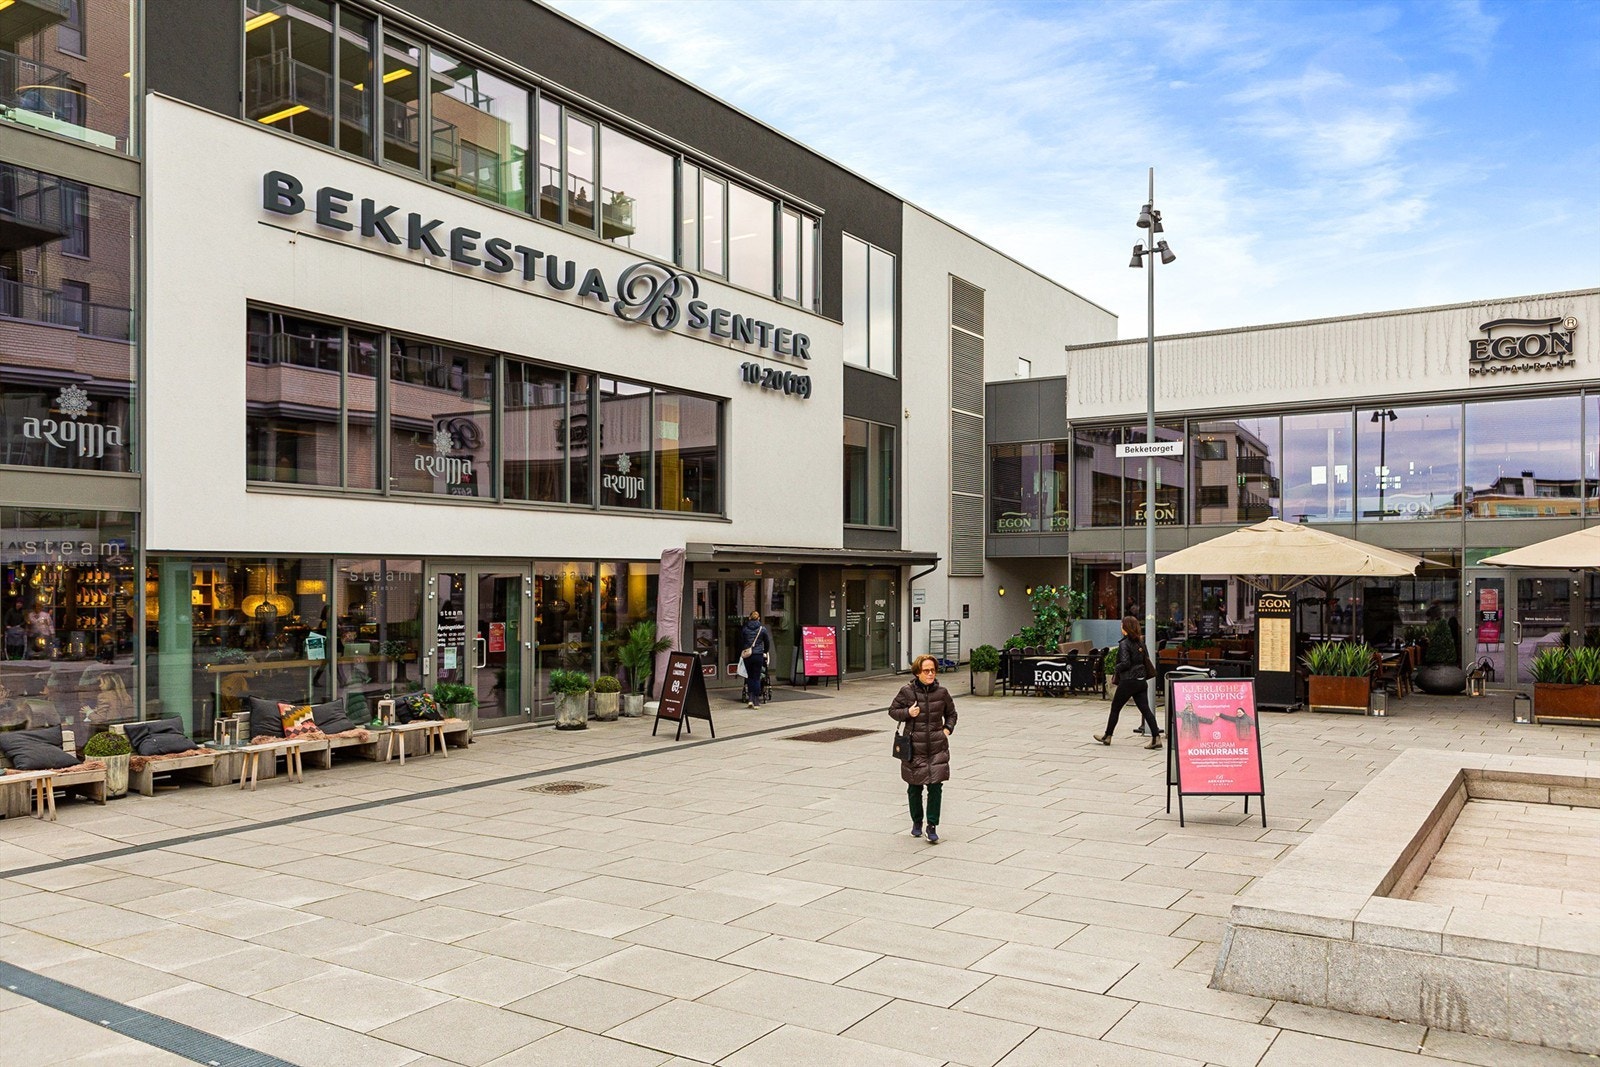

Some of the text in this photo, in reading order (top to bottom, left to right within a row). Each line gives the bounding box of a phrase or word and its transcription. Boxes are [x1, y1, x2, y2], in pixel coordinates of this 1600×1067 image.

[263, 170, 610, 303] BEKKESTUA
[687, 300, 812, 361] SENTER
[1469, 331, 1576, 363] EGON
[1468, 359, 1577, 377] RESTAURANT
[23, 416, 123, 459] aroma
[1124, 445, 1174, 454] Bekketorget
[415, 454, 473, 485] aroma
[603, 473, 646, 500] aroma
[998, 518, 1032, 528] EGON
[24, 539, 120, 556] steam
[350, 571, 412, 582] steam
[1258, 599, 1291, 608] EGON
[1034, 670, 1072, 682] EGON
[1185, 692, 1244, 701] & SHOPPING
[1188, 748, 1249, 756] KONKURRANSE
